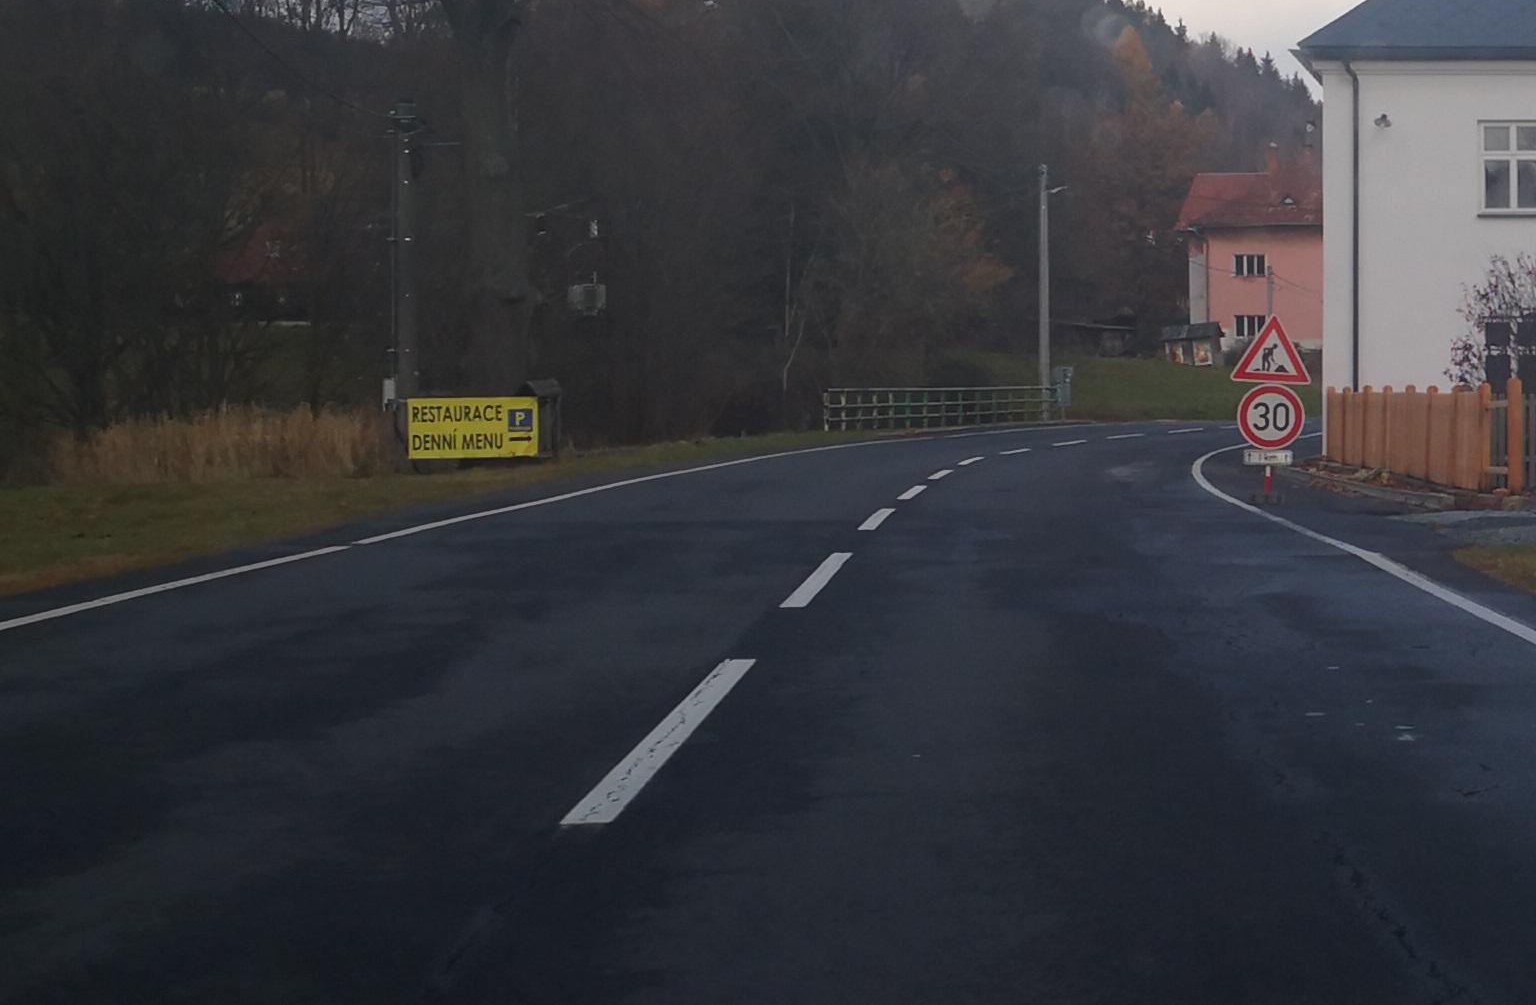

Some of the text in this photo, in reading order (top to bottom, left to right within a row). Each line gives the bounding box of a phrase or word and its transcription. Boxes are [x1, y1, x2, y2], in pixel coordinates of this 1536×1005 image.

[412, 405, 503, 423] RESTAURACE
[515, 411, 526, 426] P
[1253, 402, 1290, 431] 30
[412, 428, 504, 451] DENNÍ MENU
